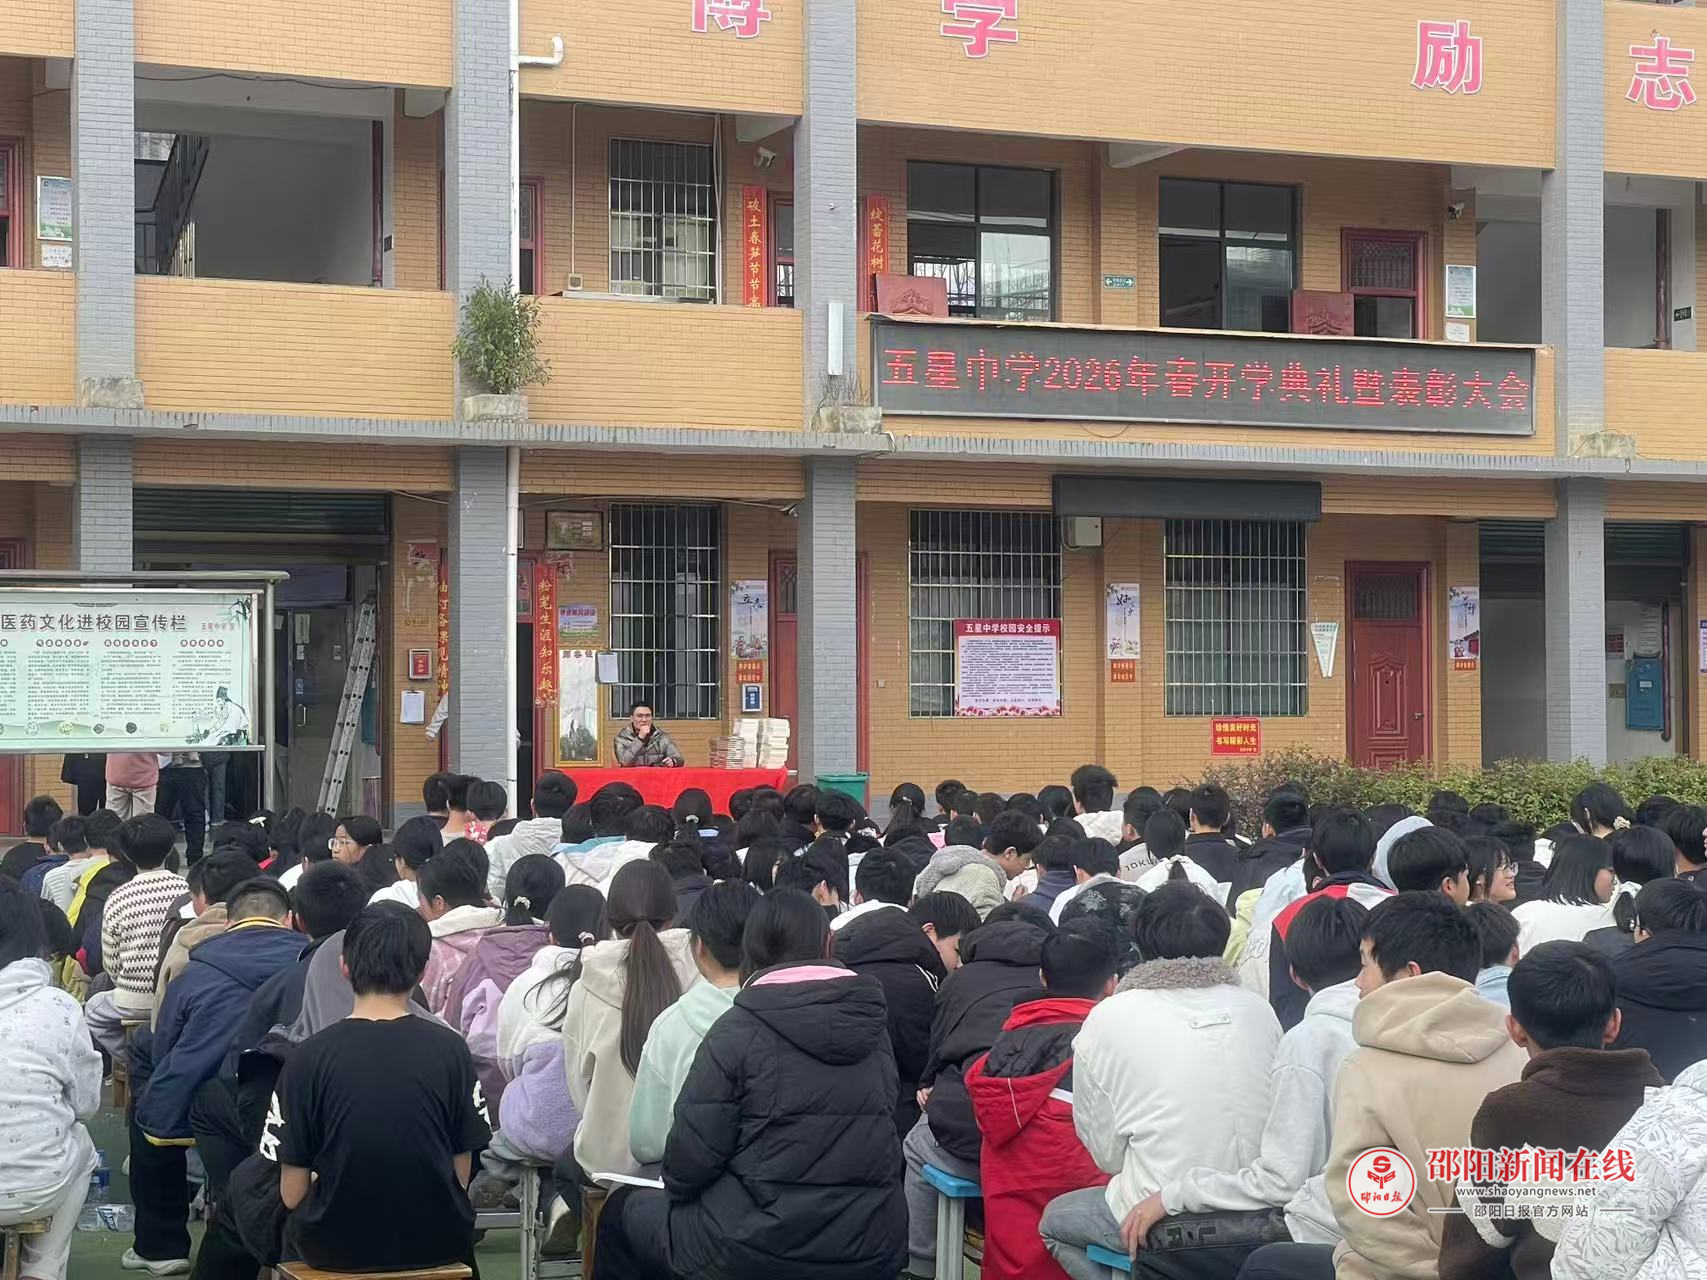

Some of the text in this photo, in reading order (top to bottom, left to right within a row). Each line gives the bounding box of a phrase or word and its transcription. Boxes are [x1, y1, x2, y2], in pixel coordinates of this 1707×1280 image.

[1410, 20, 1483, 95] 励
[1625, 37, 1697, 110] 志
[870, 207, 884, 273] 绽蕾花树
[881, 348, 1530, 410] 五星中学2026年春开学典礼暨表彰大会
[1, 613, 187, 631] 医药文化进校园宣传栏
[965, 623, 1051, 633] 五星中学校园安全提示
